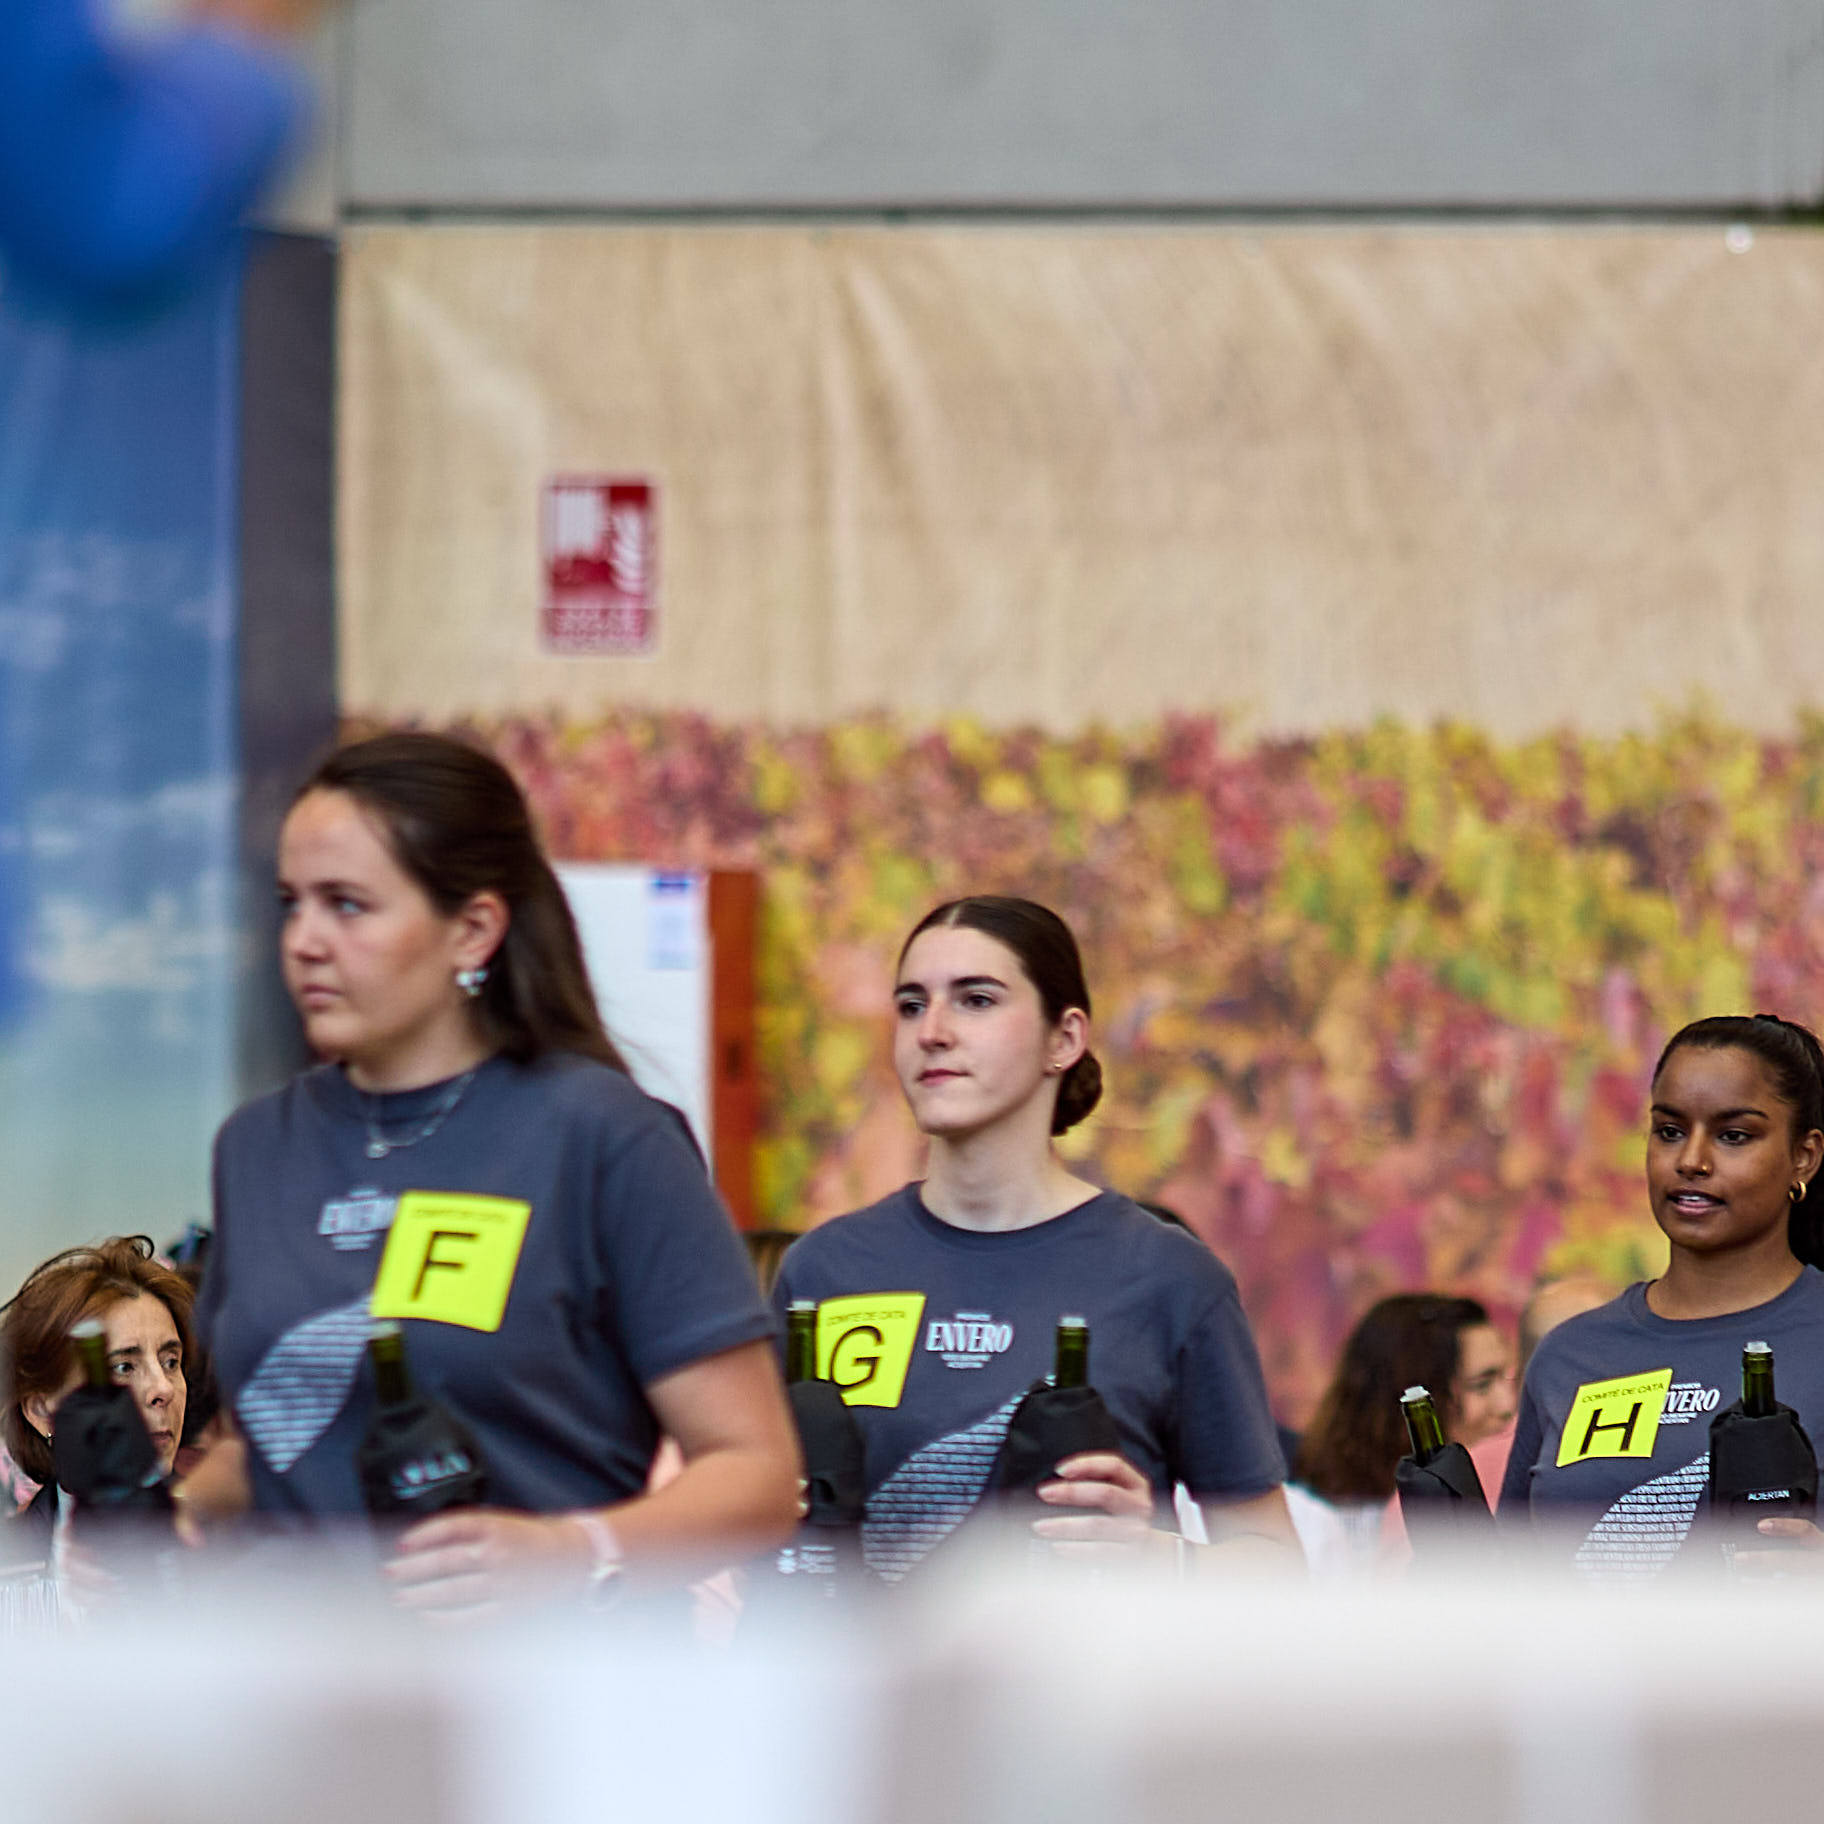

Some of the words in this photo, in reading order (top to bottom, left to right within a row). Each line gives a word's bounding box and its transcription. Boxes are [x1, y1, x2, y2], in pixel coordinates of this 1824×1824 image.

[409, 1229, 480, 1302] F
[830, 1324, 885, 1391] G
[925, 1321, 1014, 1353] ENVERO
[1621, 1387, 1635, 1396] DE
[1637, 1382, 1664, 1394] CATA
[1663, 1388, 1721, 1413] VERO
[1578, 1401, 1643, 1457] H
